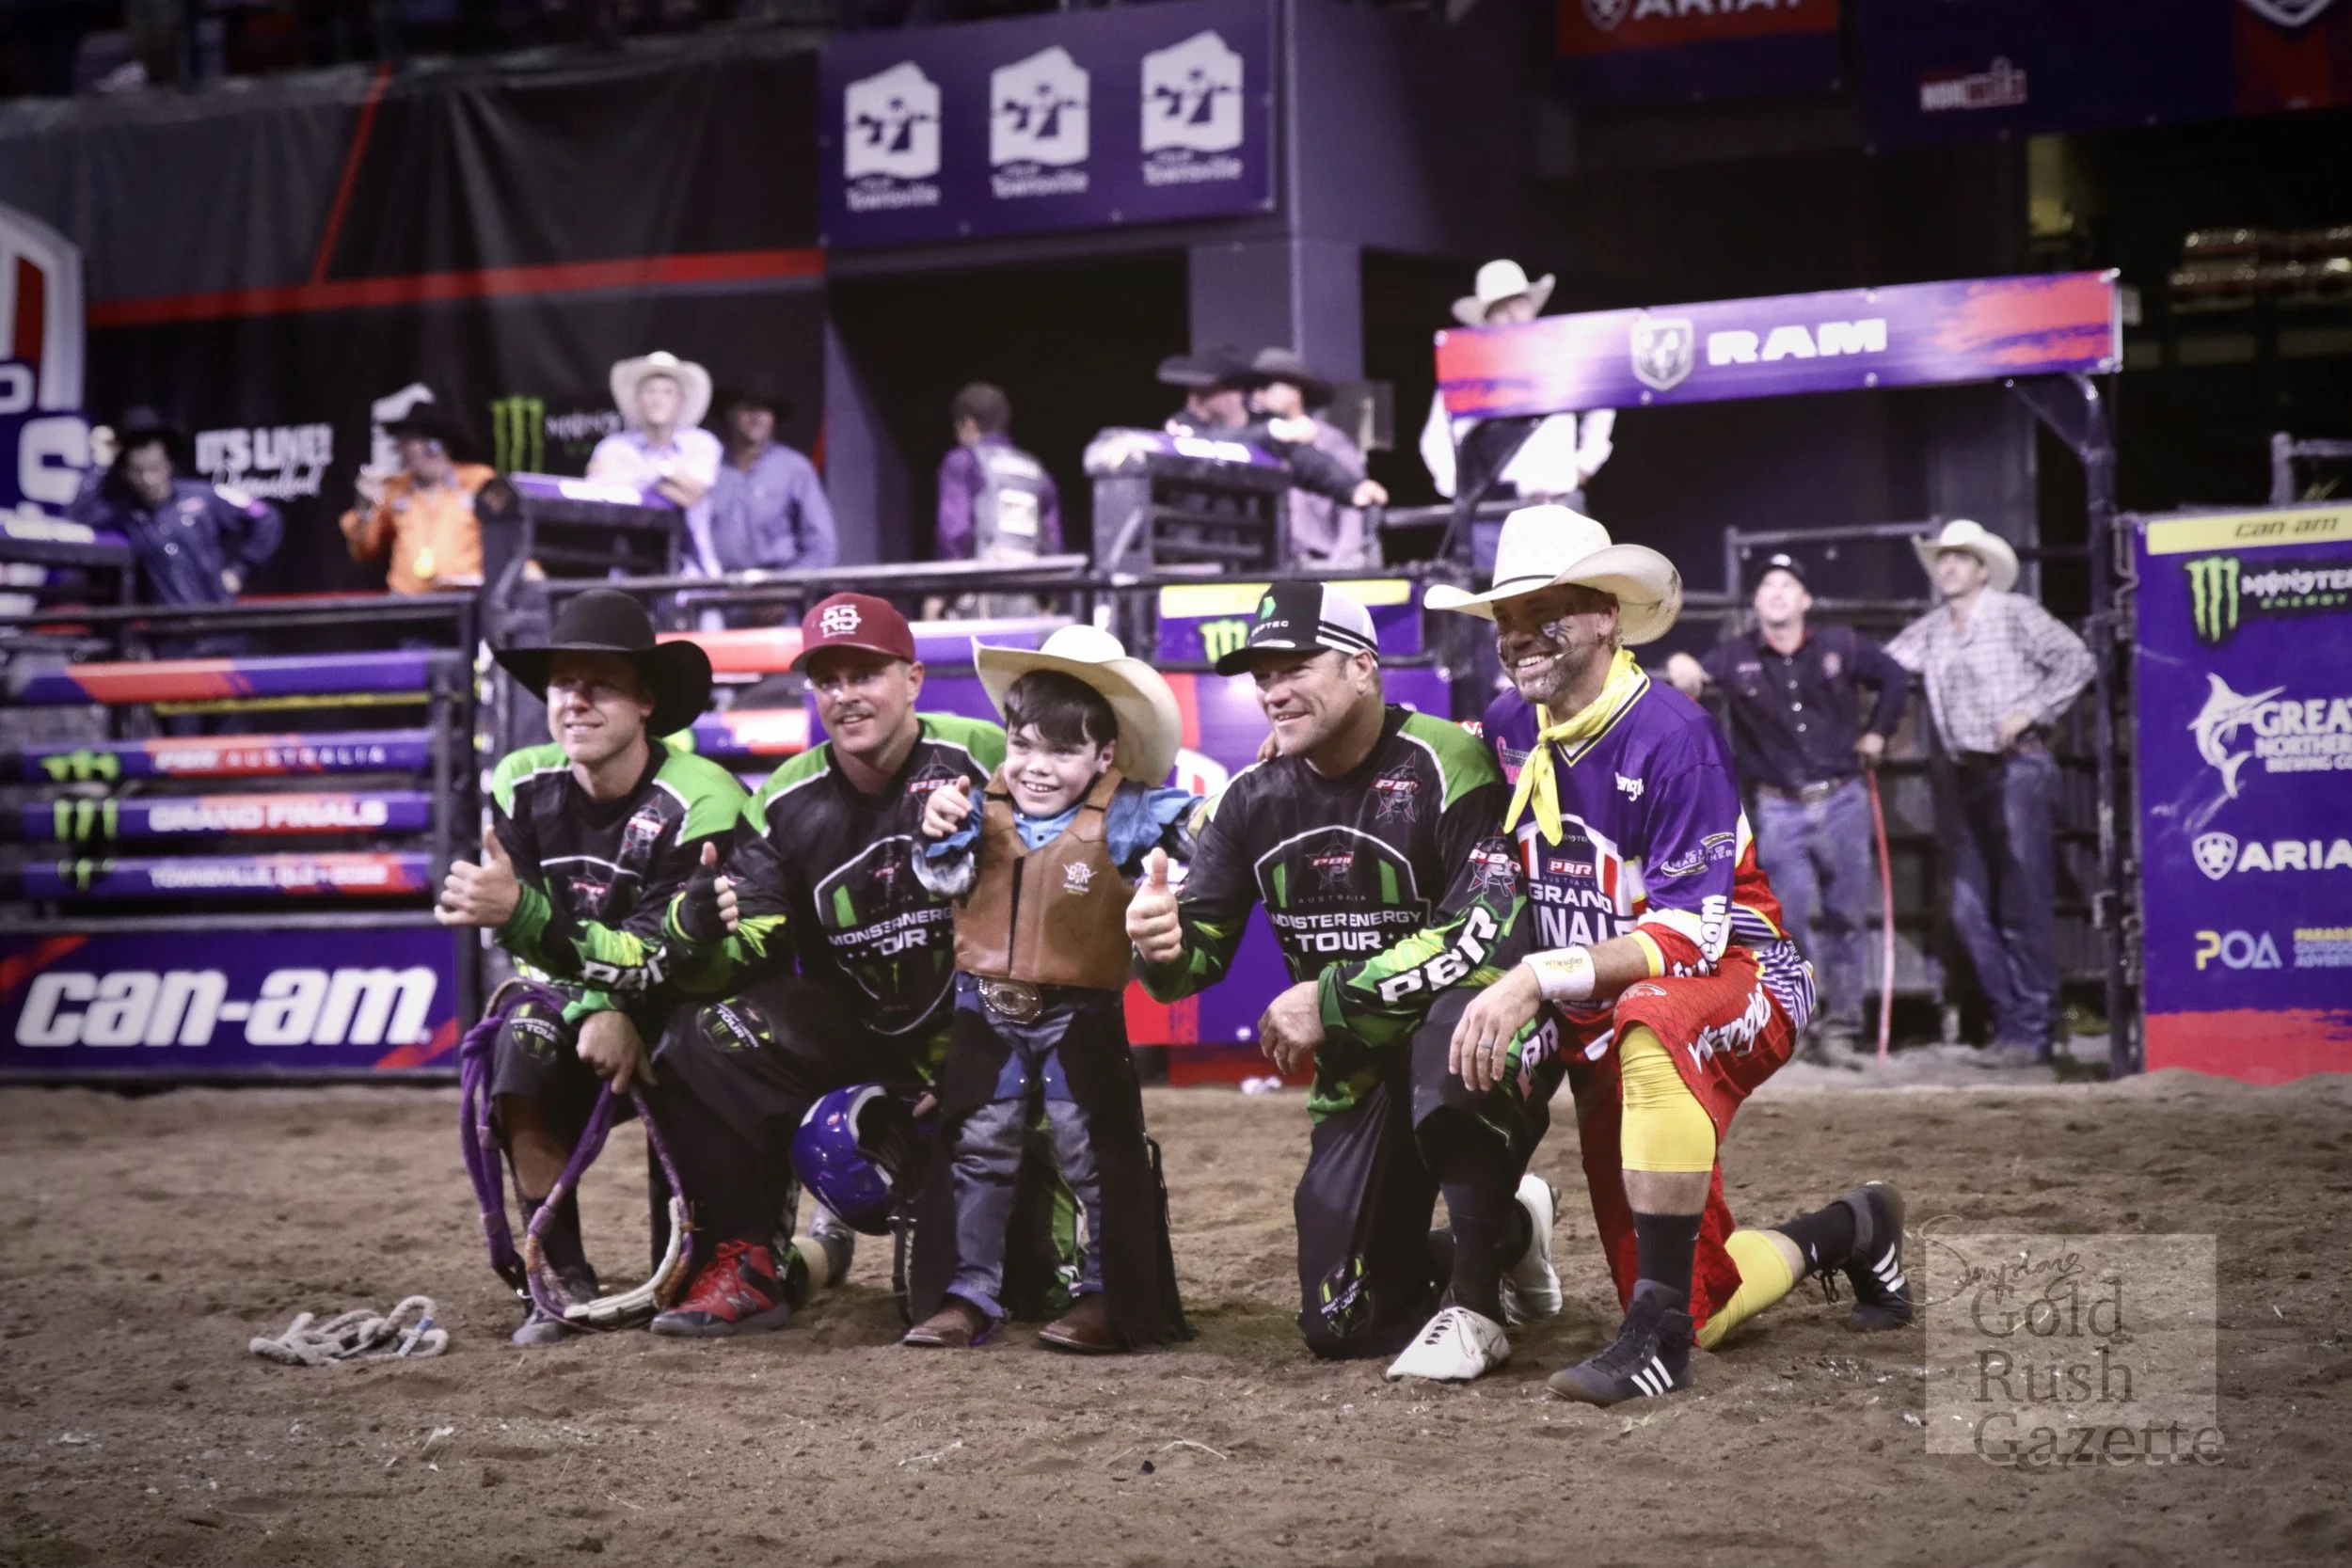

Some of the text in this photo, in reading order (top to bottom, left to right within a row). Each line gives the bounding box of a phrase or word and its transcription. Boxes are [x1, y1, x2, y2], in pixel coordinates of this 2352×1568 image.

[1708, 318, 1887, 366] RAM
[2241, 567, 2352, 597] MONSTE
[2251, 697, 2352, 737] GREA
[1549, 859, 1593, 876] PBR
[1670, 849, 1734, 870] MACHINER
[2236, 838, 2352, 872] ARIA
[1528, 882, 1613, 914] GRAND
[1349, 910, 1422, 927] ENERGY
[1295, 930, 1383, 953] TOUR
[1378, 906, 1500, 1004] PBR
[2195, 928, 2283, 971] POA
[14, 967, 437, 1046] can-am
